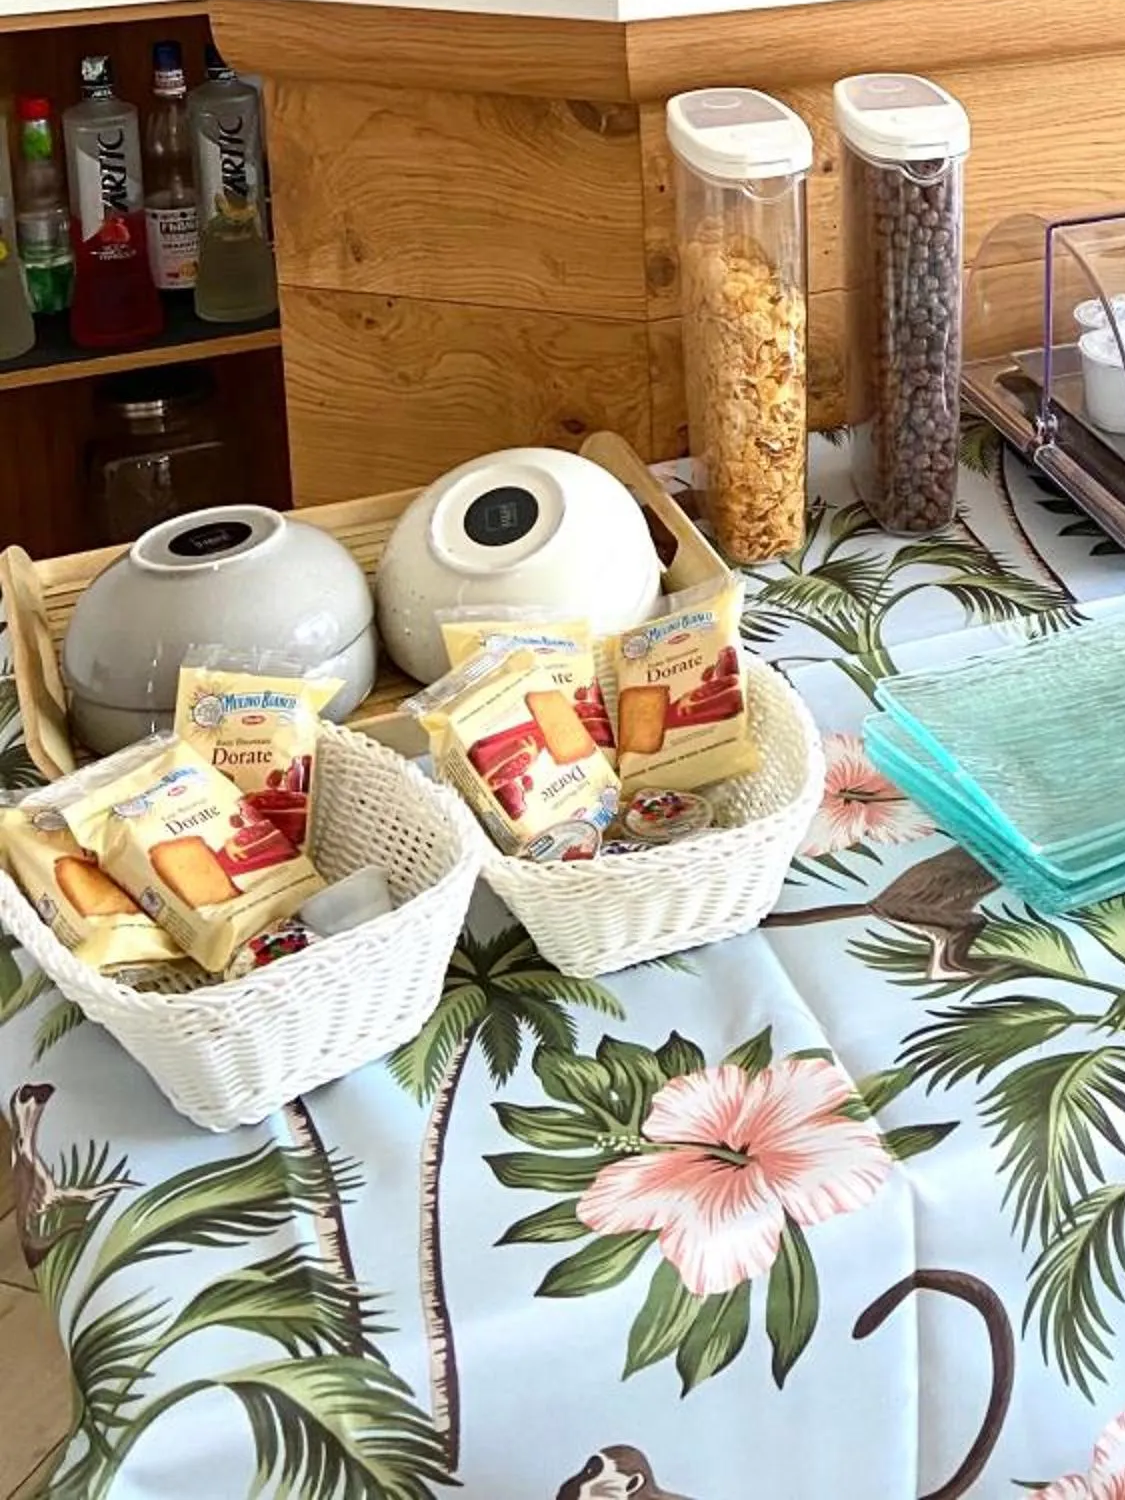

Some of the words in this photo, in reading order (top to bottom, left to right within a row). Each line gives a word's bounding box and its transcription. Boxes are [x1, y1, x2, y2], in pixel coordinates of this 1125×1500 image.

[646, 655, 703, 683] Dorate
[211, 746, 274, 766] Dorate
[164, 805, 221, 836] Dorate
